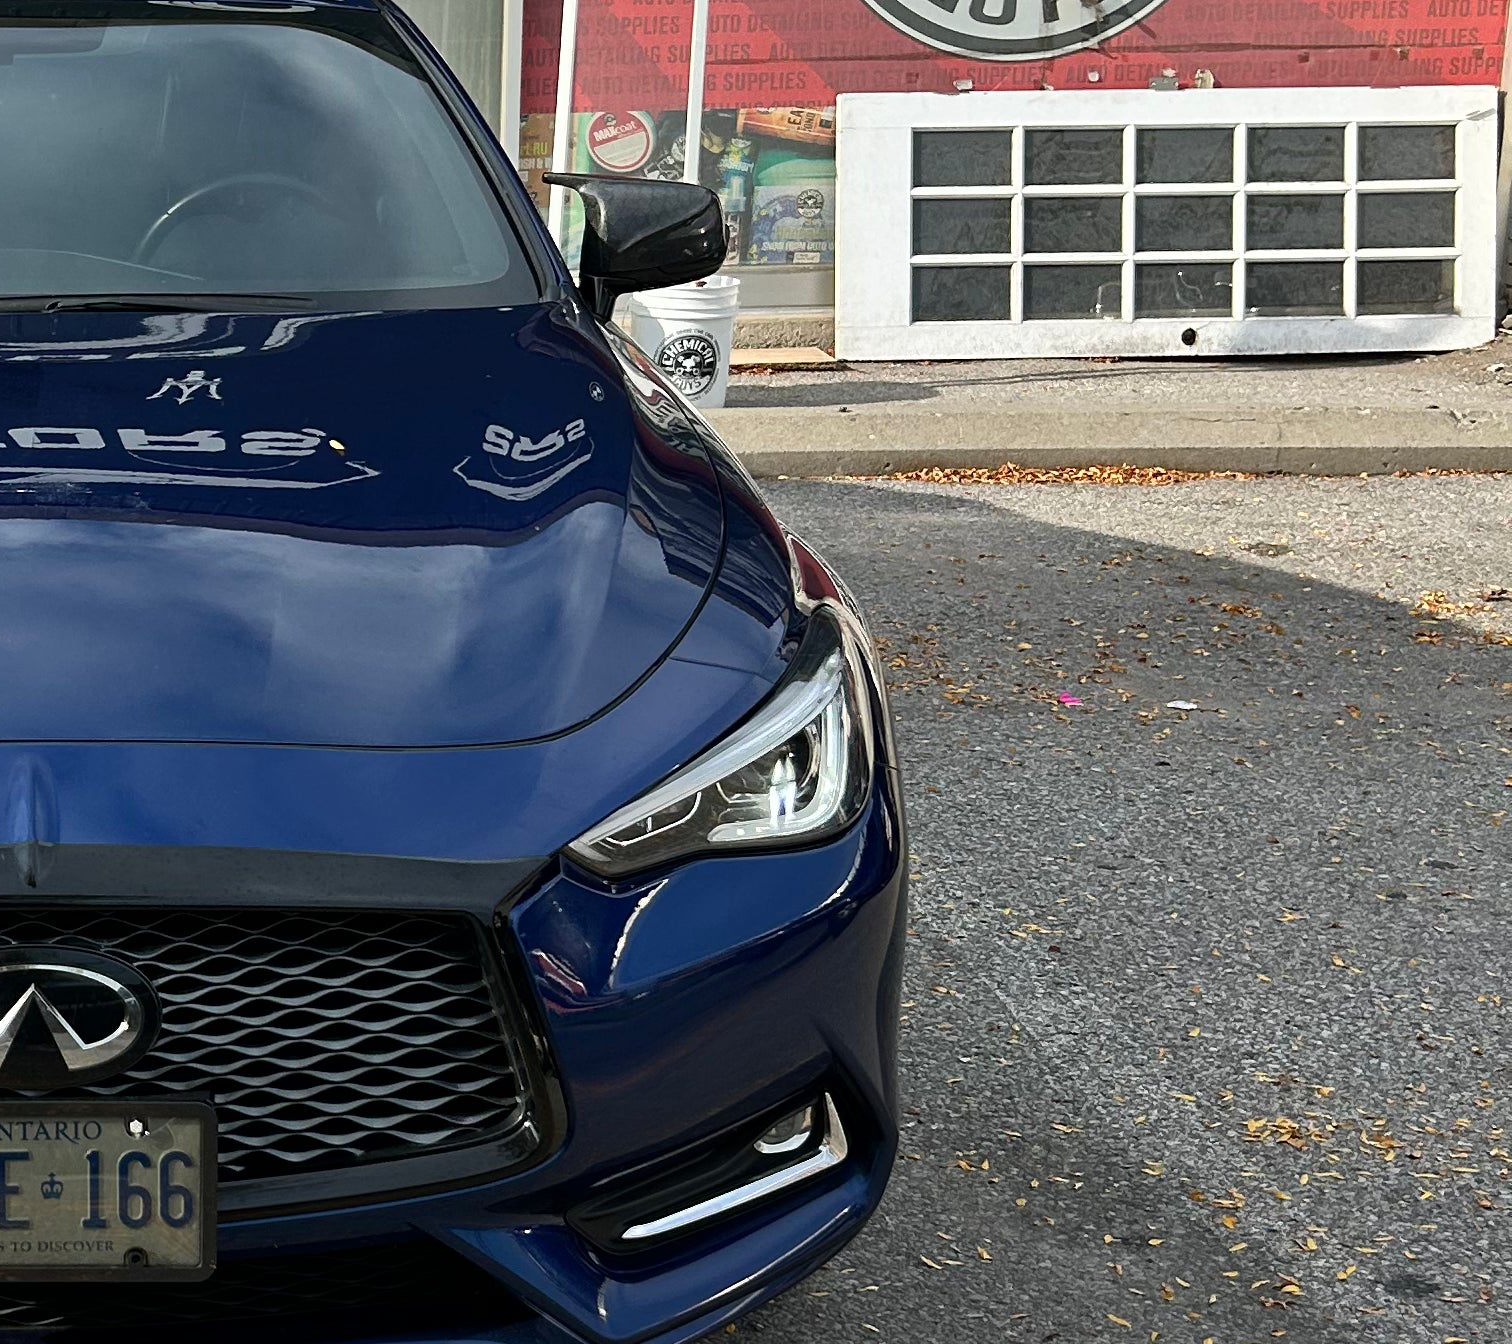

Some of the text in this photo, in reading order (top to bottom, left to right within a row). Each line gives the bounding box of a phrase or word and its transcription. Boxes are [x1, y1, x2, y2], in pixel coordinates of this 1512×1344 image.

[1326, 0, 1410, 19] SUPPLIES
[723, 71, 806, 92] SUPPLIES
[662, 338, 715, 367] CHEMICAL
[80, 1149, 194, 1230] 166
[9, 1240, 32, 1254] TO
[36, 1239, 115, 1254] DISCOVER
